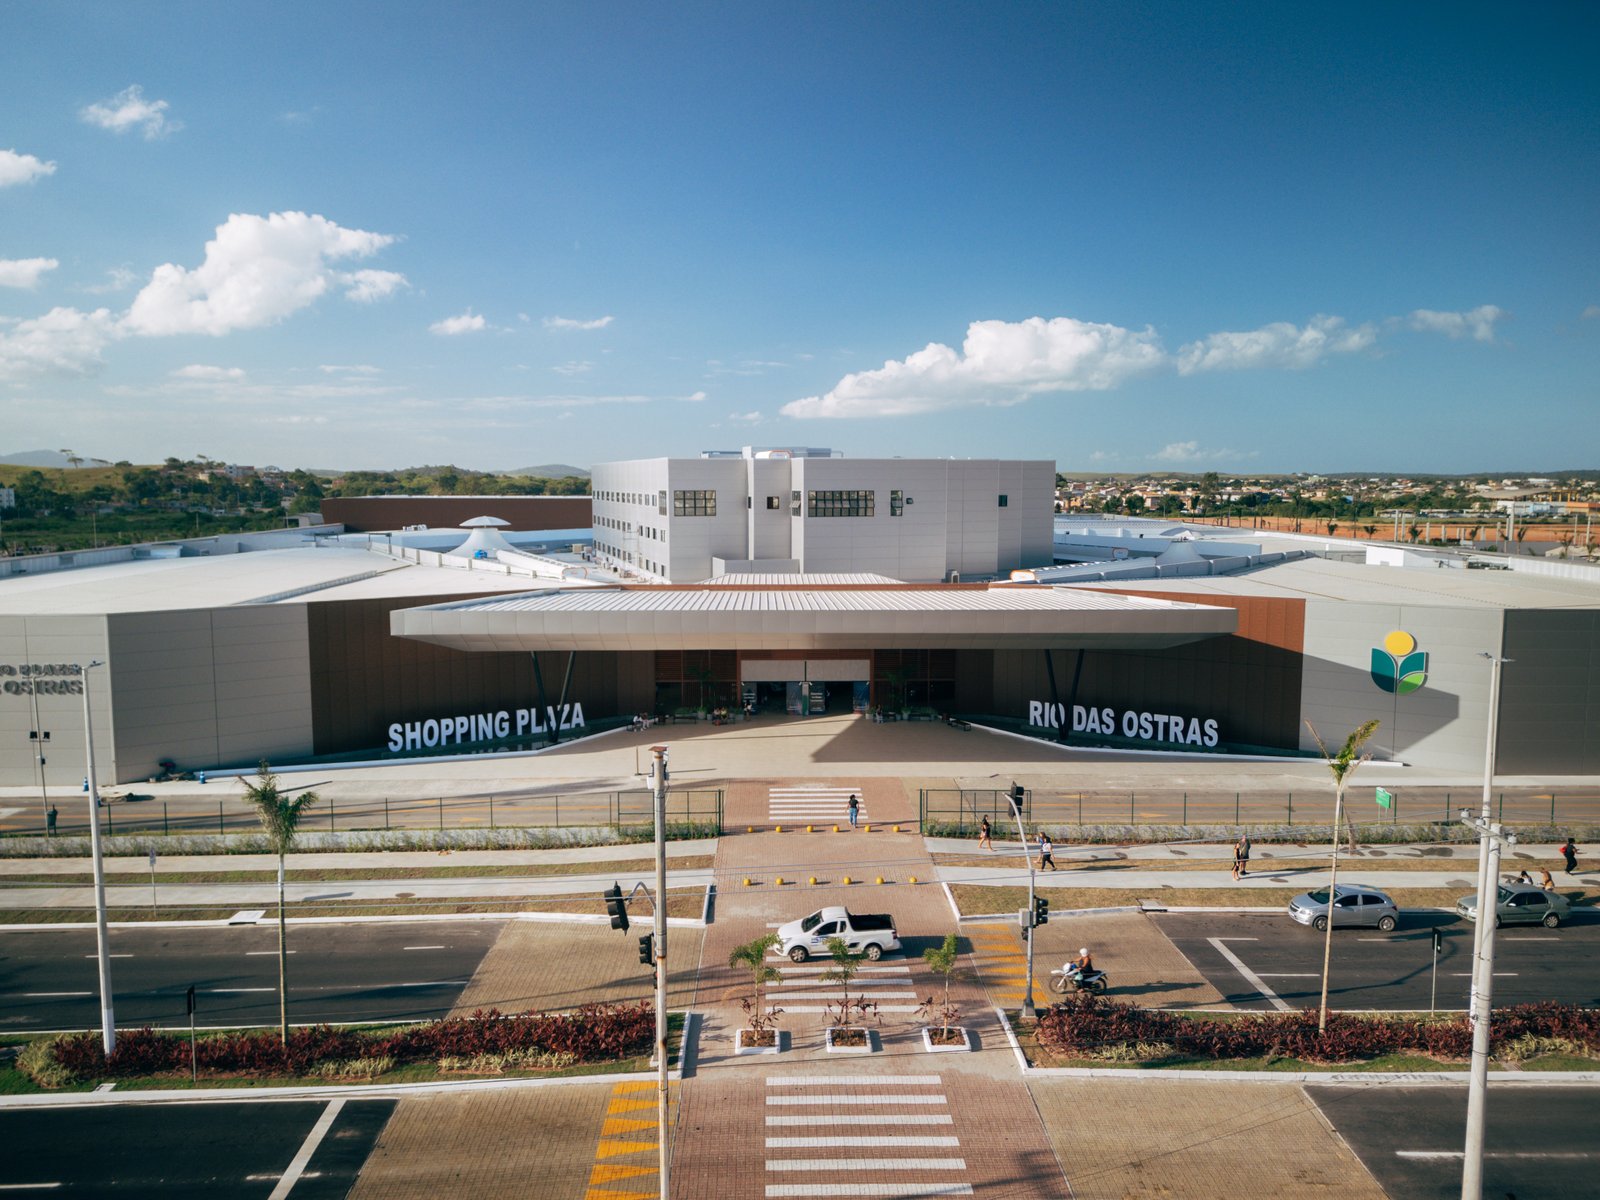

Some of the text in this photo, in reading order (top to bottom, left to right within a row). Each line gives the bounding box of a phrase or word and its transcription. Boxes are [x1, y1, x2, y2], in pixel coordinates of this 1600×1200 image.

[388, 711, 509, 752] SHOPPING
[1029, 700, 1219, 747] RIO DAS OSTRAS
